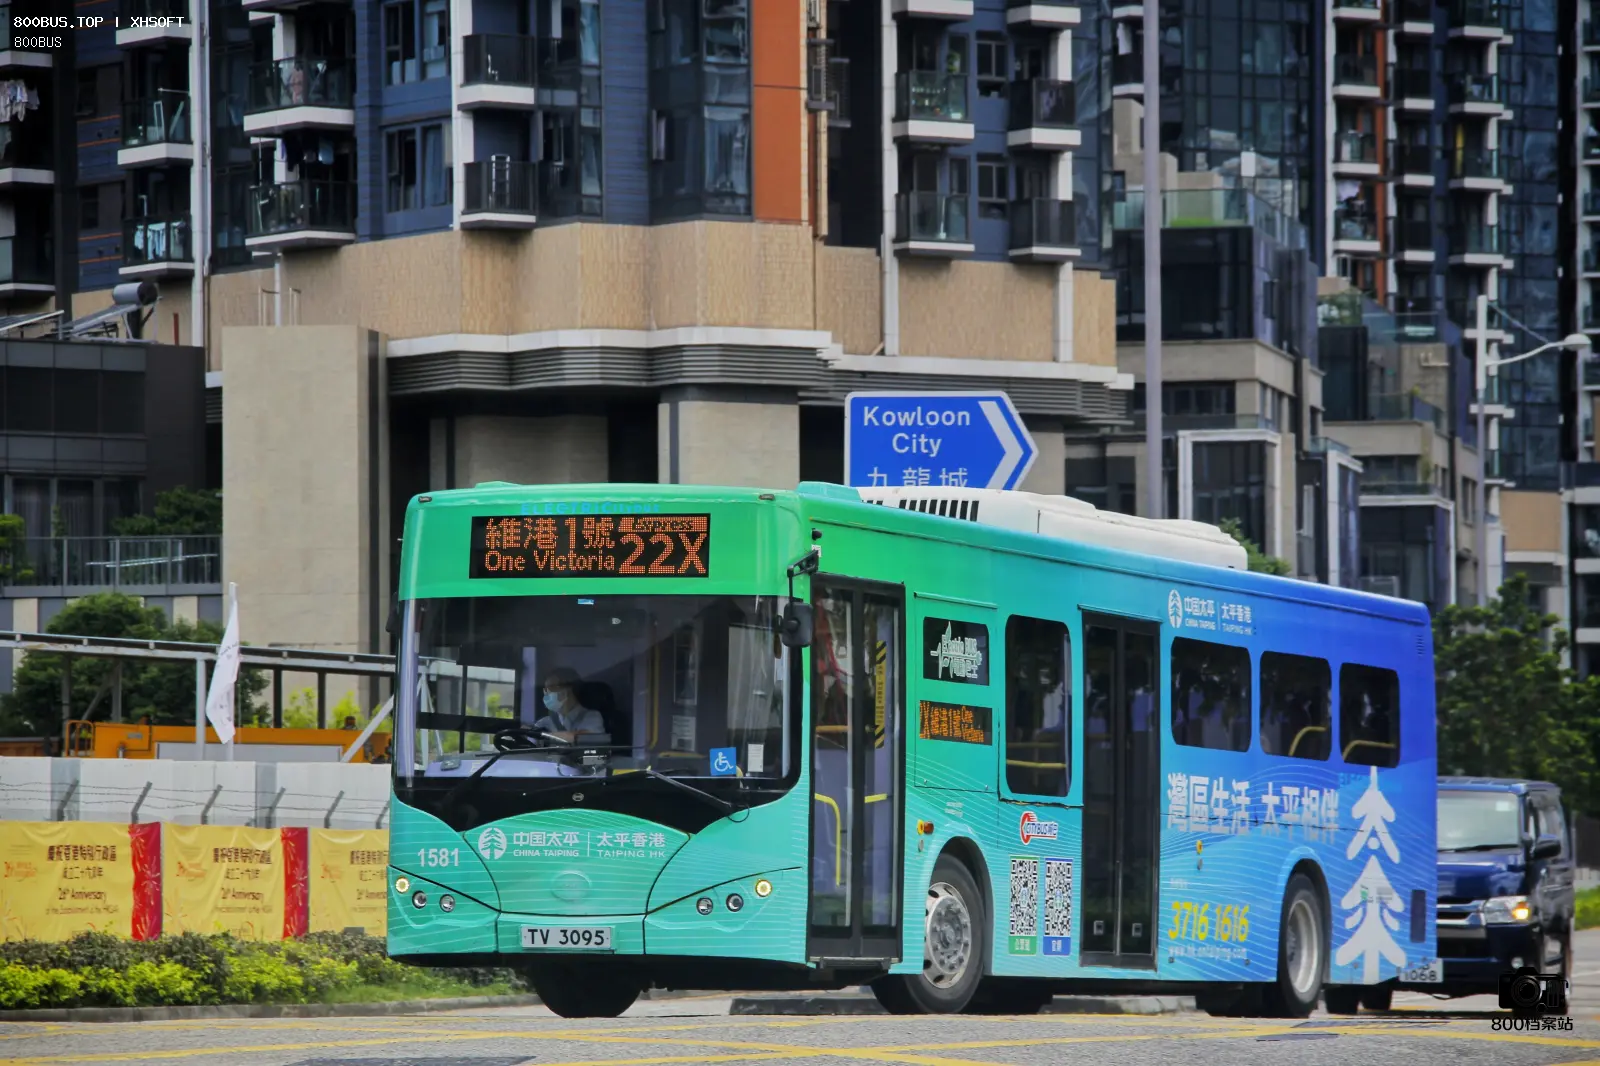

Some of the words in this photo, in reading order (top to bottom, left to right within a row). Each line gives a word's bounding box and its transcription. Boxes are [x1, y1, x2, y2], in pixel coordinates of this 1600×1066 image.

[863, 406, 970, 426] Kowloon
[892, 432, 942, 457] City
[485, 517, 616, 549] 維港1號
[484, 550, 526, 571] One
[533, 550, 615, 571] Victoria
[619, 532, 708, 574] 22X
[1183, 596, 1216, 618] 中国太平
[1221, 602, 1252, 624] 太平香港
[1167, 772, 1251, 835] 灣區生活
[1261, 781, 1339, 845] 太平相伴
[513, 831, 580, 847] 中国太平
[596, 832, 666, 848] 太平香港
[418, 848, 460, 868] 1581
[513, 849, 541, 857] CHINA
[544, 849, 580, 857] TAIPING
[597, 849, 645, 858] TAIPING
[650, 850, 666, 858] HK
[1168, 901, 1209, 941] 3716
[1215, 904, 1250, 943] 1616
[527, 929, 550, 945] TV
[559, 929, 605, 946] 3095
